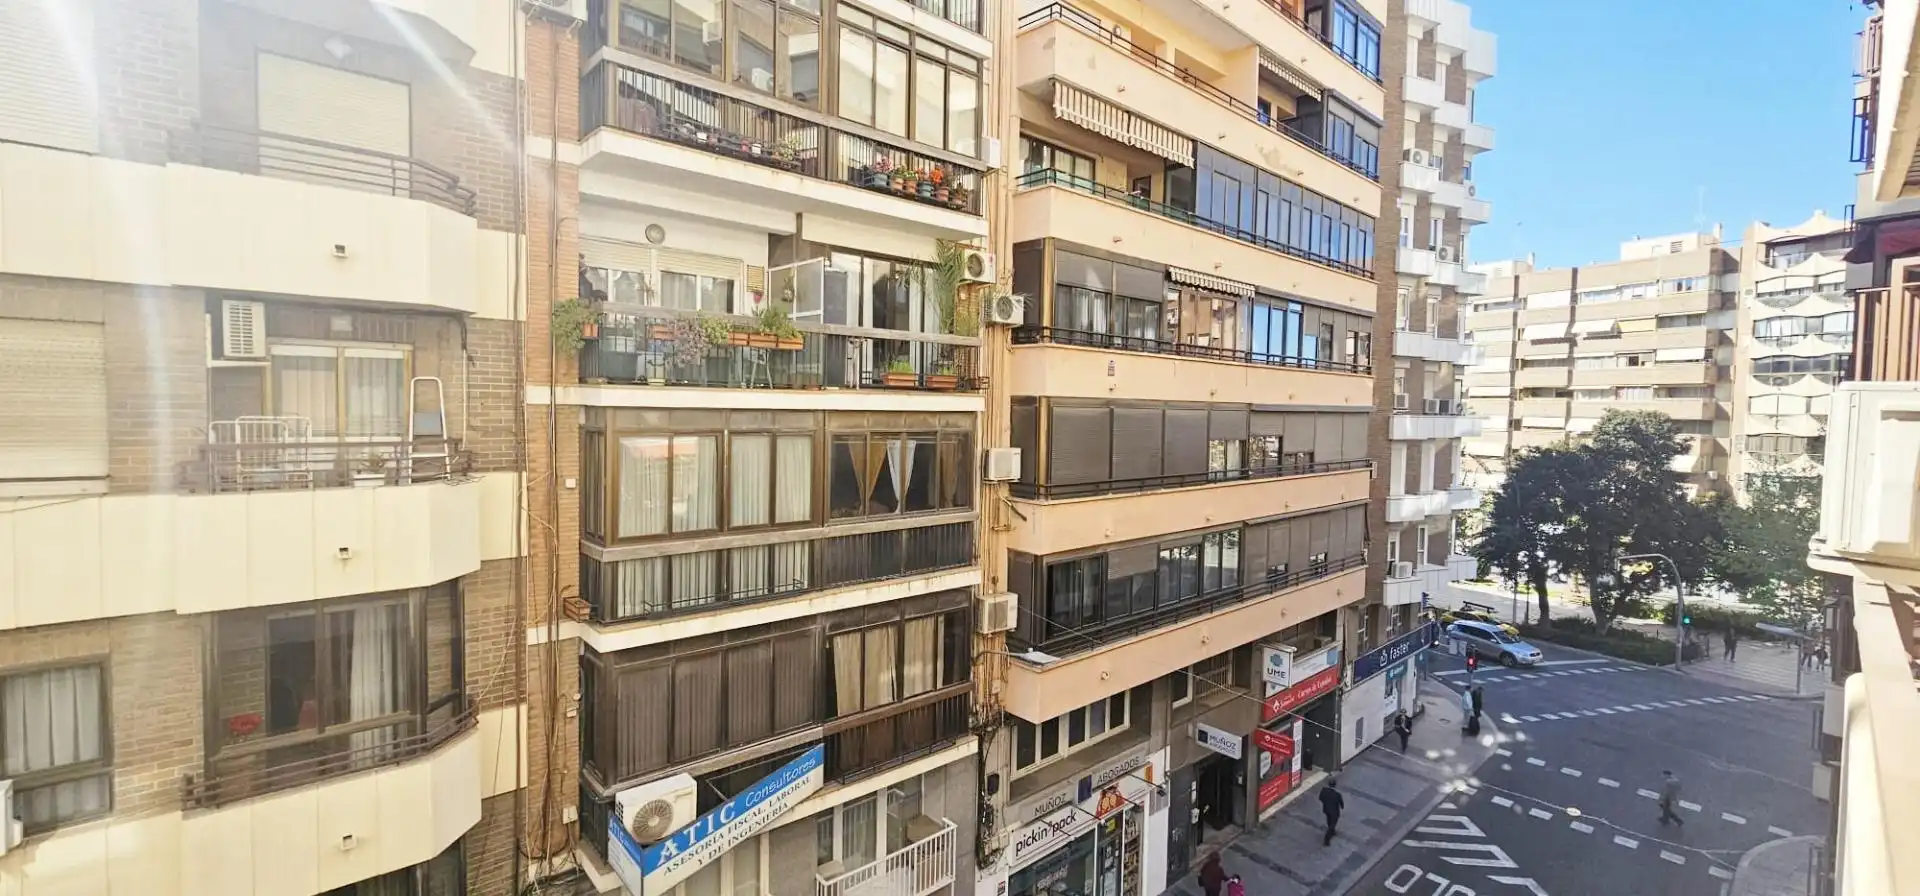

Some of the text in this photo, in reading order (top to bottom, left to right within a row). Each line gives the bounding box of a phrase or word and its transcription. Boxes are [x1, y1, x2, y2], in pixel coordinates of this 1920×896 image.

[1390, 641, 1410, 660] faster
[1267, 667, 1287, 679] UME
[1034, 756, 1140, 816] MUÑOZ ABOGADOS
[657, 801, 735, 867] ATIC
[745, 757, 816, 807] Consultores
[664, 831, 724, 876] ASESORÍA
[769, 776, 810, 808] LABORAL
[697, 857, 705, 866] Y
[708, 843, 725, 860] DE
